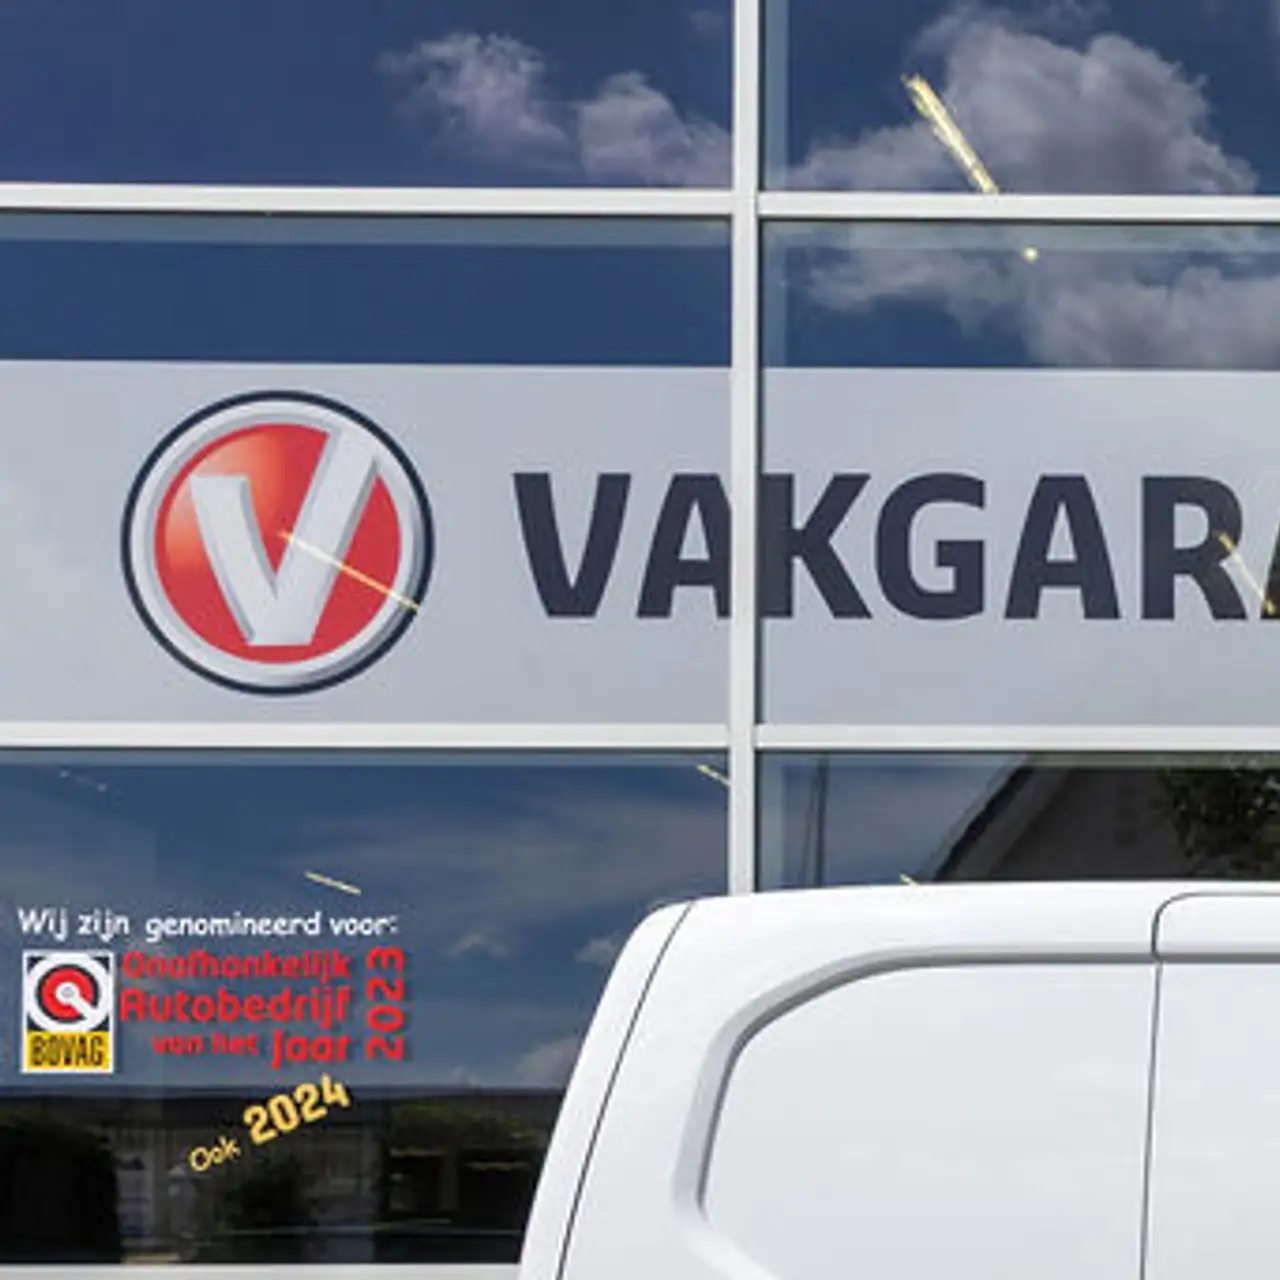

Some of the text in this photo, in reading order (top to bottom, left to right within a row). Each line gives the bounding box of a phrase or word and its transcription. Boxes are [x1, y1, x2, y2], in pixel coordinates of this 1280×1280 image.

[17, 907, 69, 942] Wij
[76, 907, 131, 943] zijn
[144, 911, 321, 943] genomineerd
[118, 986, 353, 1029] Autobedrijf
[366, 945, 405, 1061] 2023
[30, 1034, 105, 1067] BOVAG
[151, 1034, 204, 1056] van
[210, 1031, 260, 1056] het
[188, 1072, 353, 1173] Ook 2024
